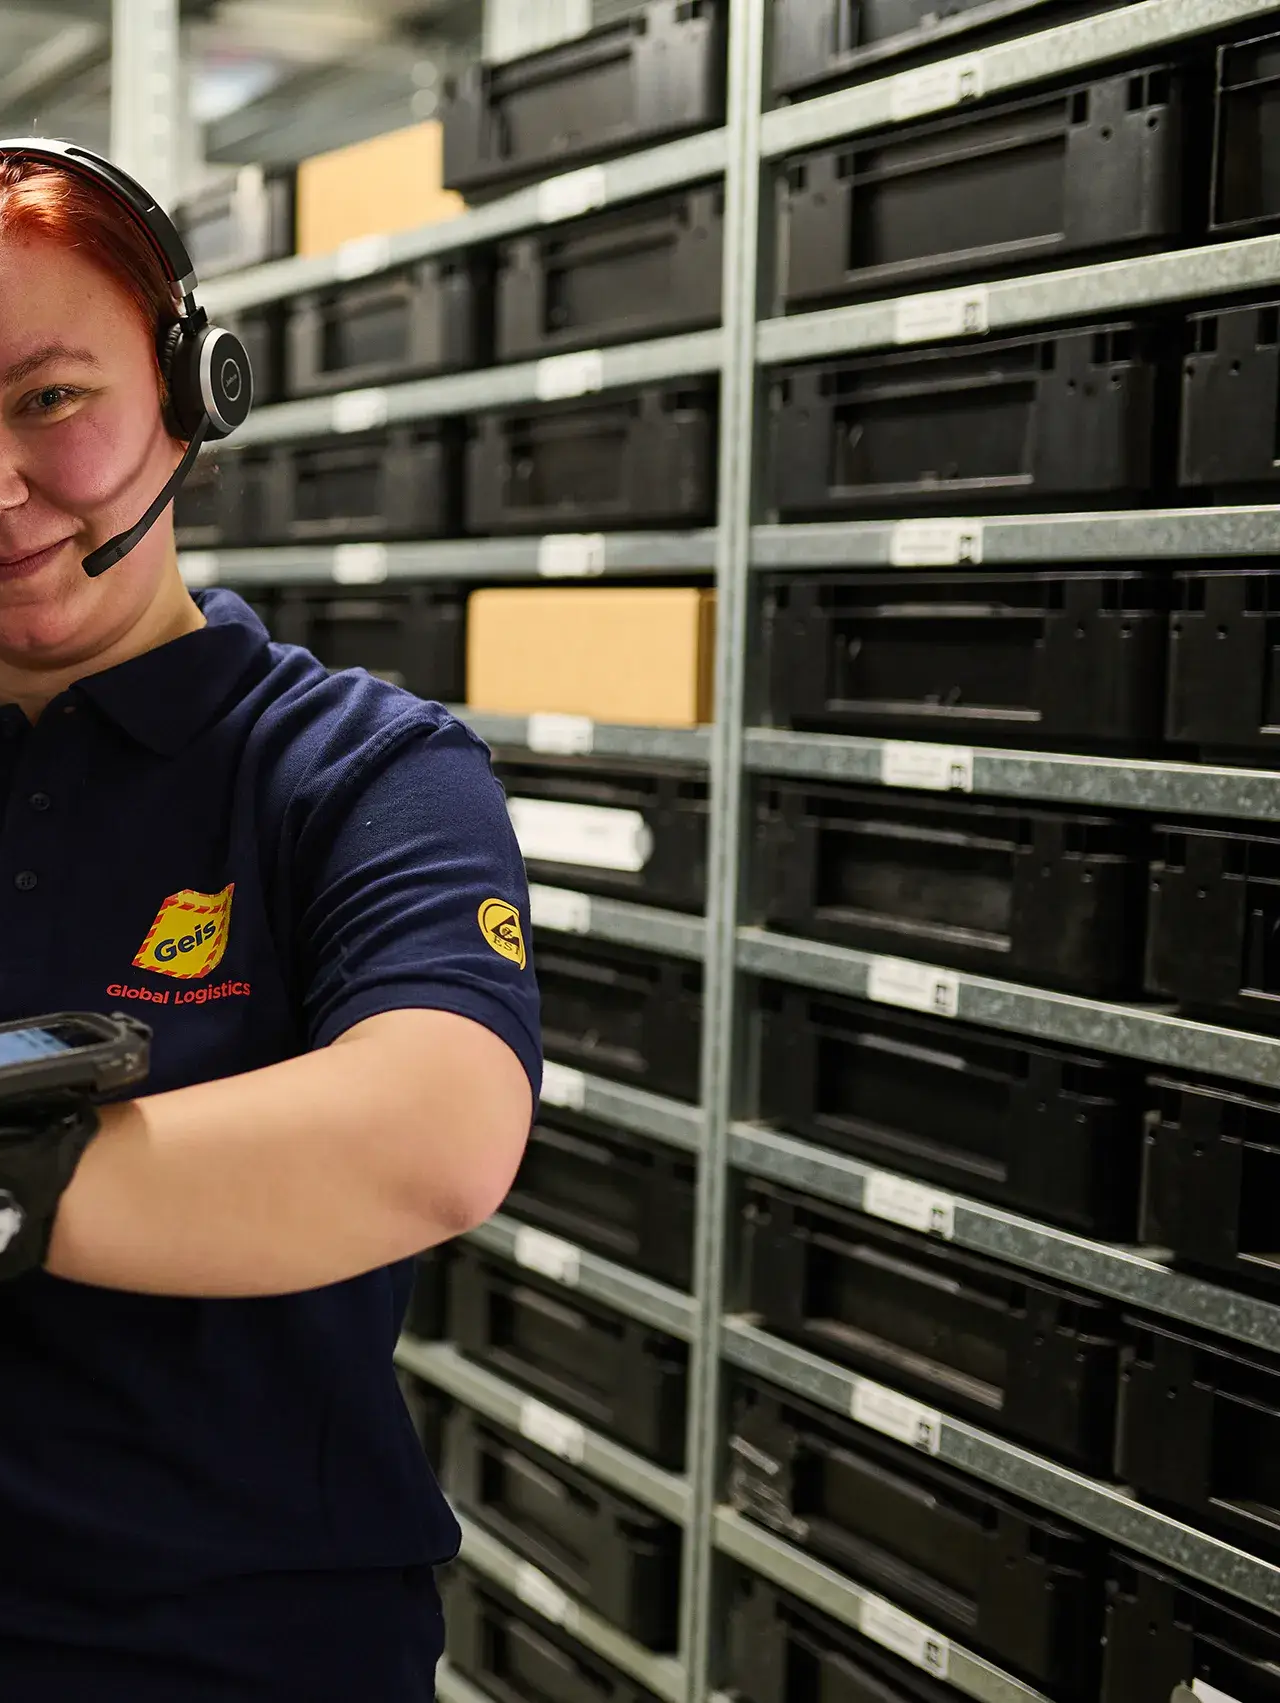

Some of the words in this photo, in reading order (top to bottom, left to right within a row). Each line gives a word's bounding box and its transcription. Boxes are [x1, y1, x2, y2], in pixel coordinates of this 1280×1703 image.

[154, 919, 217, 963] Geis
[106, 984, 171, 1005] Global
[174, 980, 251, 1005] Logistics
